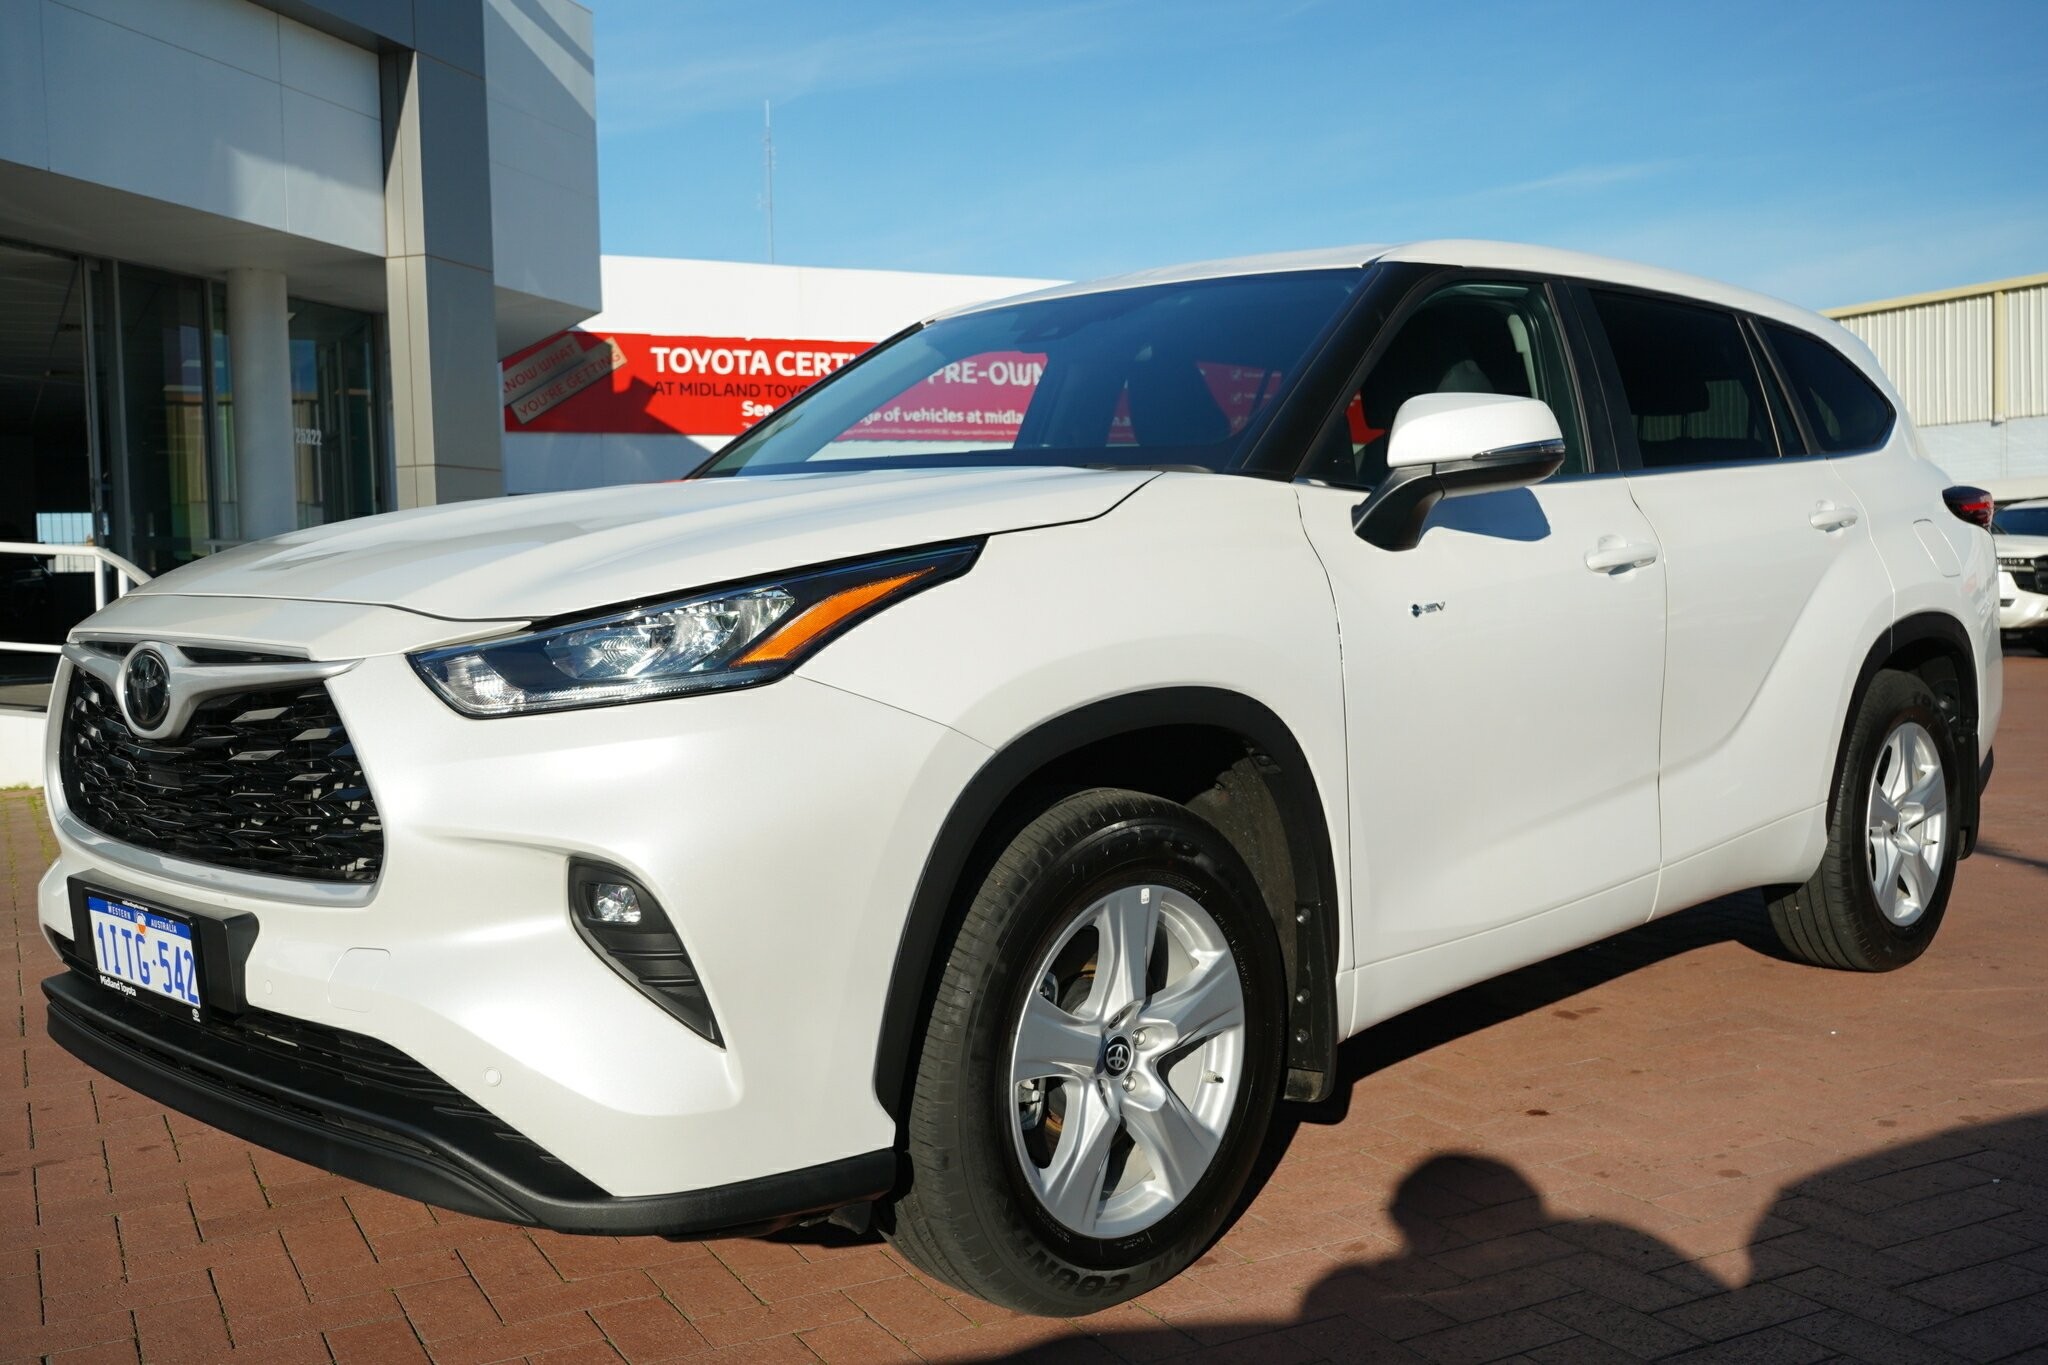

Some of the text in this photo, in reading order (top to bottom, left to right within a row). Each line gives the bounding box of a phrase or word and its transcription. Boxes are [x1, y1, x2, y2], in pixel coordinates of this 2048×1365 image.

[540, 343, 576, 372] WHAT
[650, 347, 771, 376] TOYOTA
[518, 351, 621, 416] YOU'RE GETTING
[654, 382, 675, 397] AT
[679, 383, 761, 398] MIDLAND
[883, 406, 901, 423] of
[902, 407, 965, 424] vehicles
[966, 409, 983, 425] at
[107, 905, 131, 920] WESTERN
[150, 918, 178, 934] AUSTRALIA
[100, 975, 137, 997] Midland Toyota
